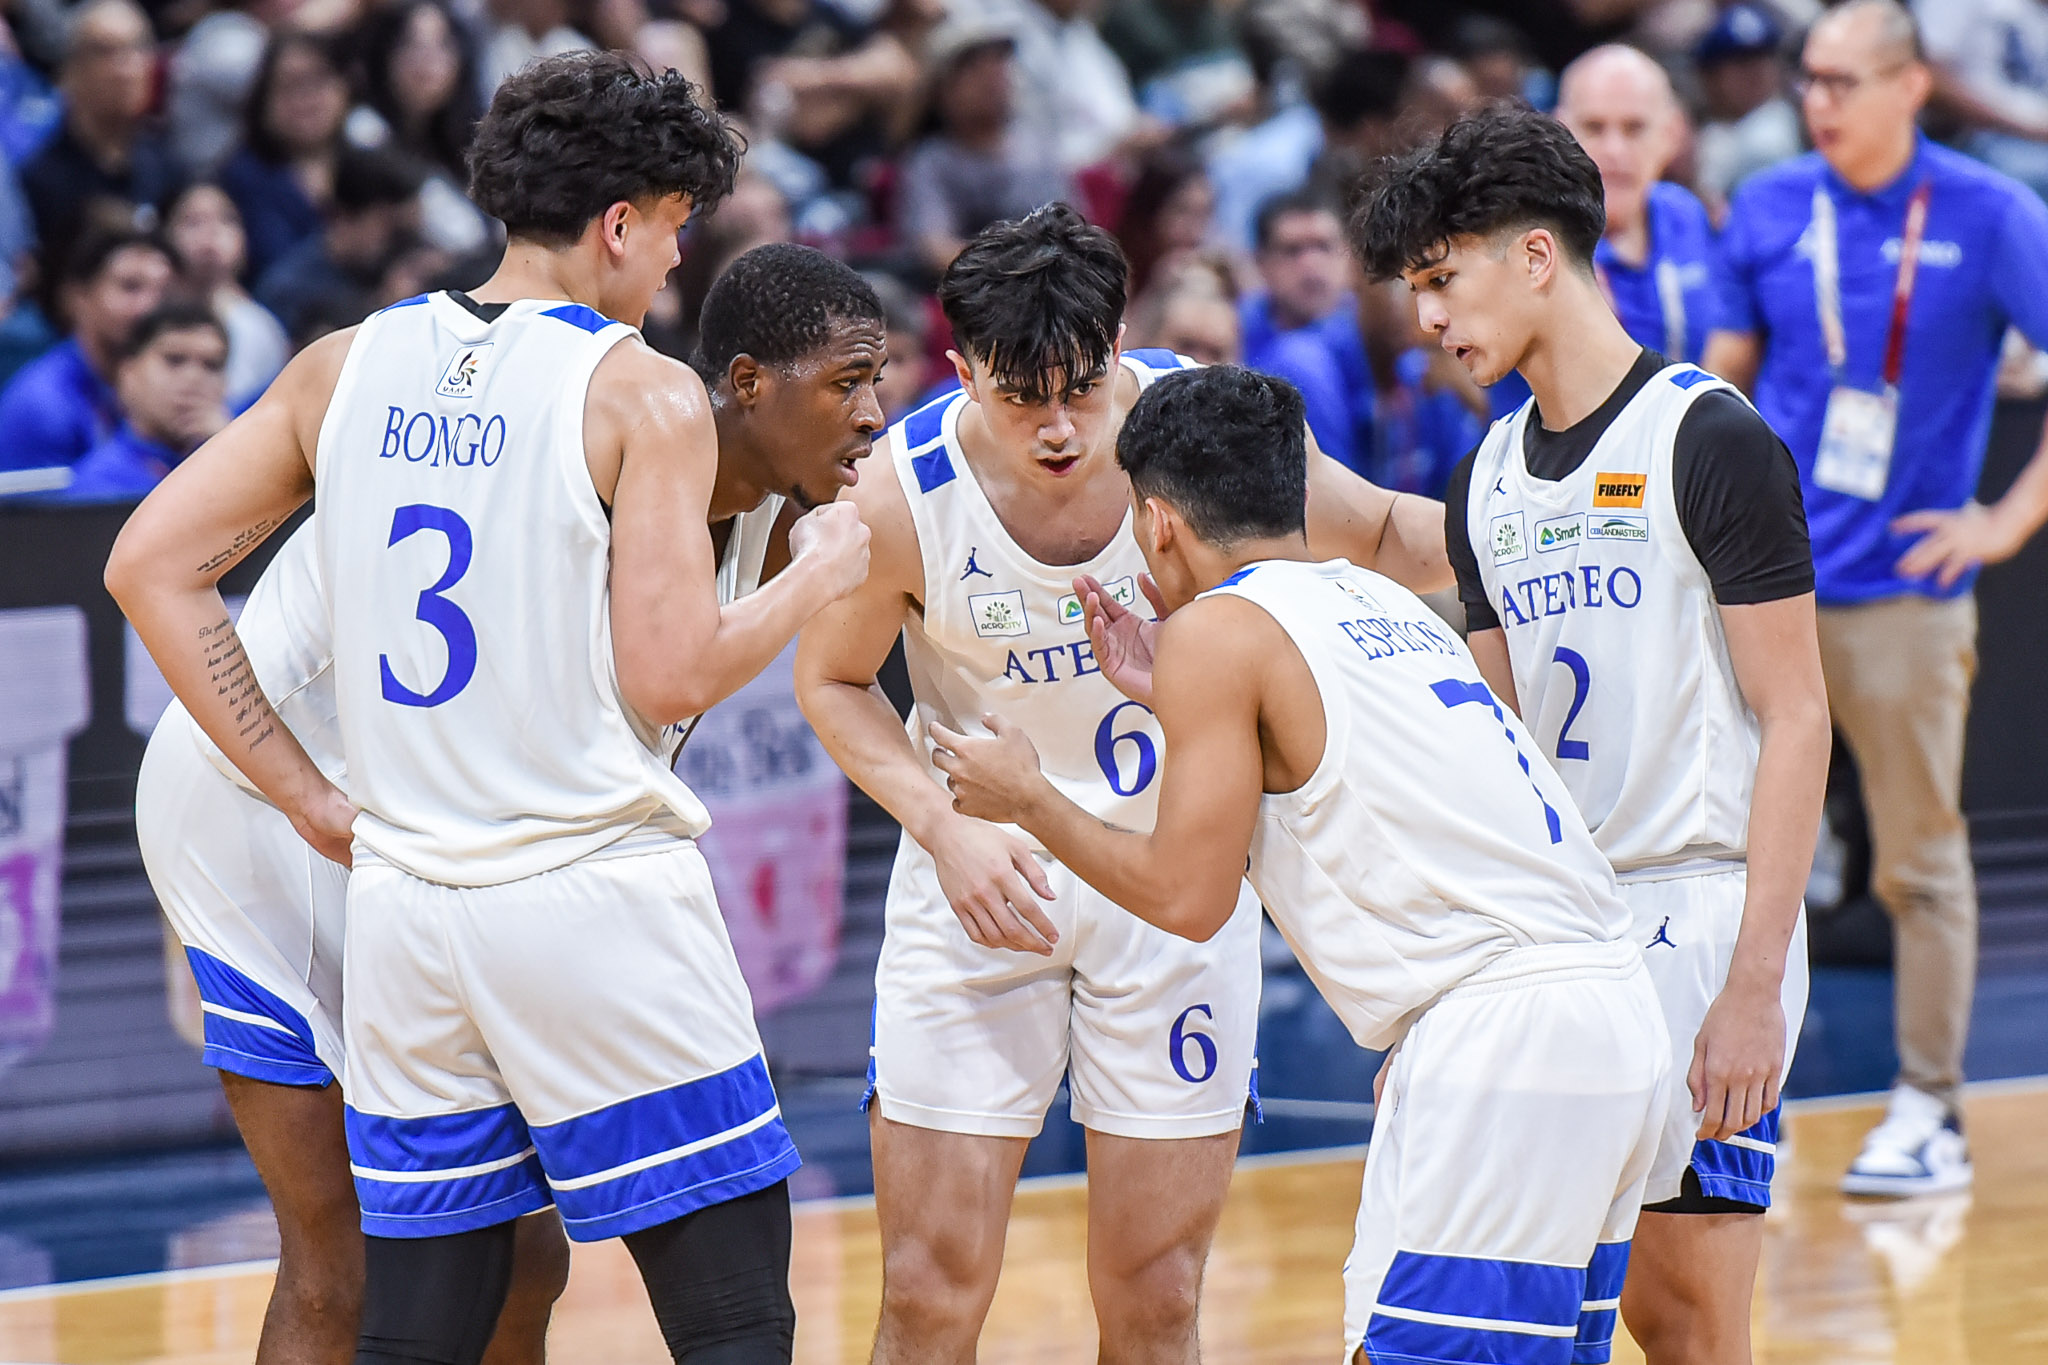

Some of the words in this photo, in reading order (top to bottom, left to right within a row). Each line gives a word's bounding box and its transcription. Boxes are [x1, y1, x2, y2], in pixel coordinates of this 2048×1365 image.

[443, 386, 466, 394] UAAP
[379, 405, 506, 467] BONGO
[1598, 483, 1644, 498] FIREFLY
[1554, 522, 1581, 542] Smart
[379, 503, 477, 707] 3
[981, 620, 1022, 630] ACROCITY
[1503, 565, 1642, 629] ATENEO
[1003, 639, 1101, 684] ATE
[1553, 646, 1590, 761] 2
[1094, 700, 1157, 797] 6
[1428, 678, 1563, 845] 7
[1169, 1004, 1217, 1083] 6
